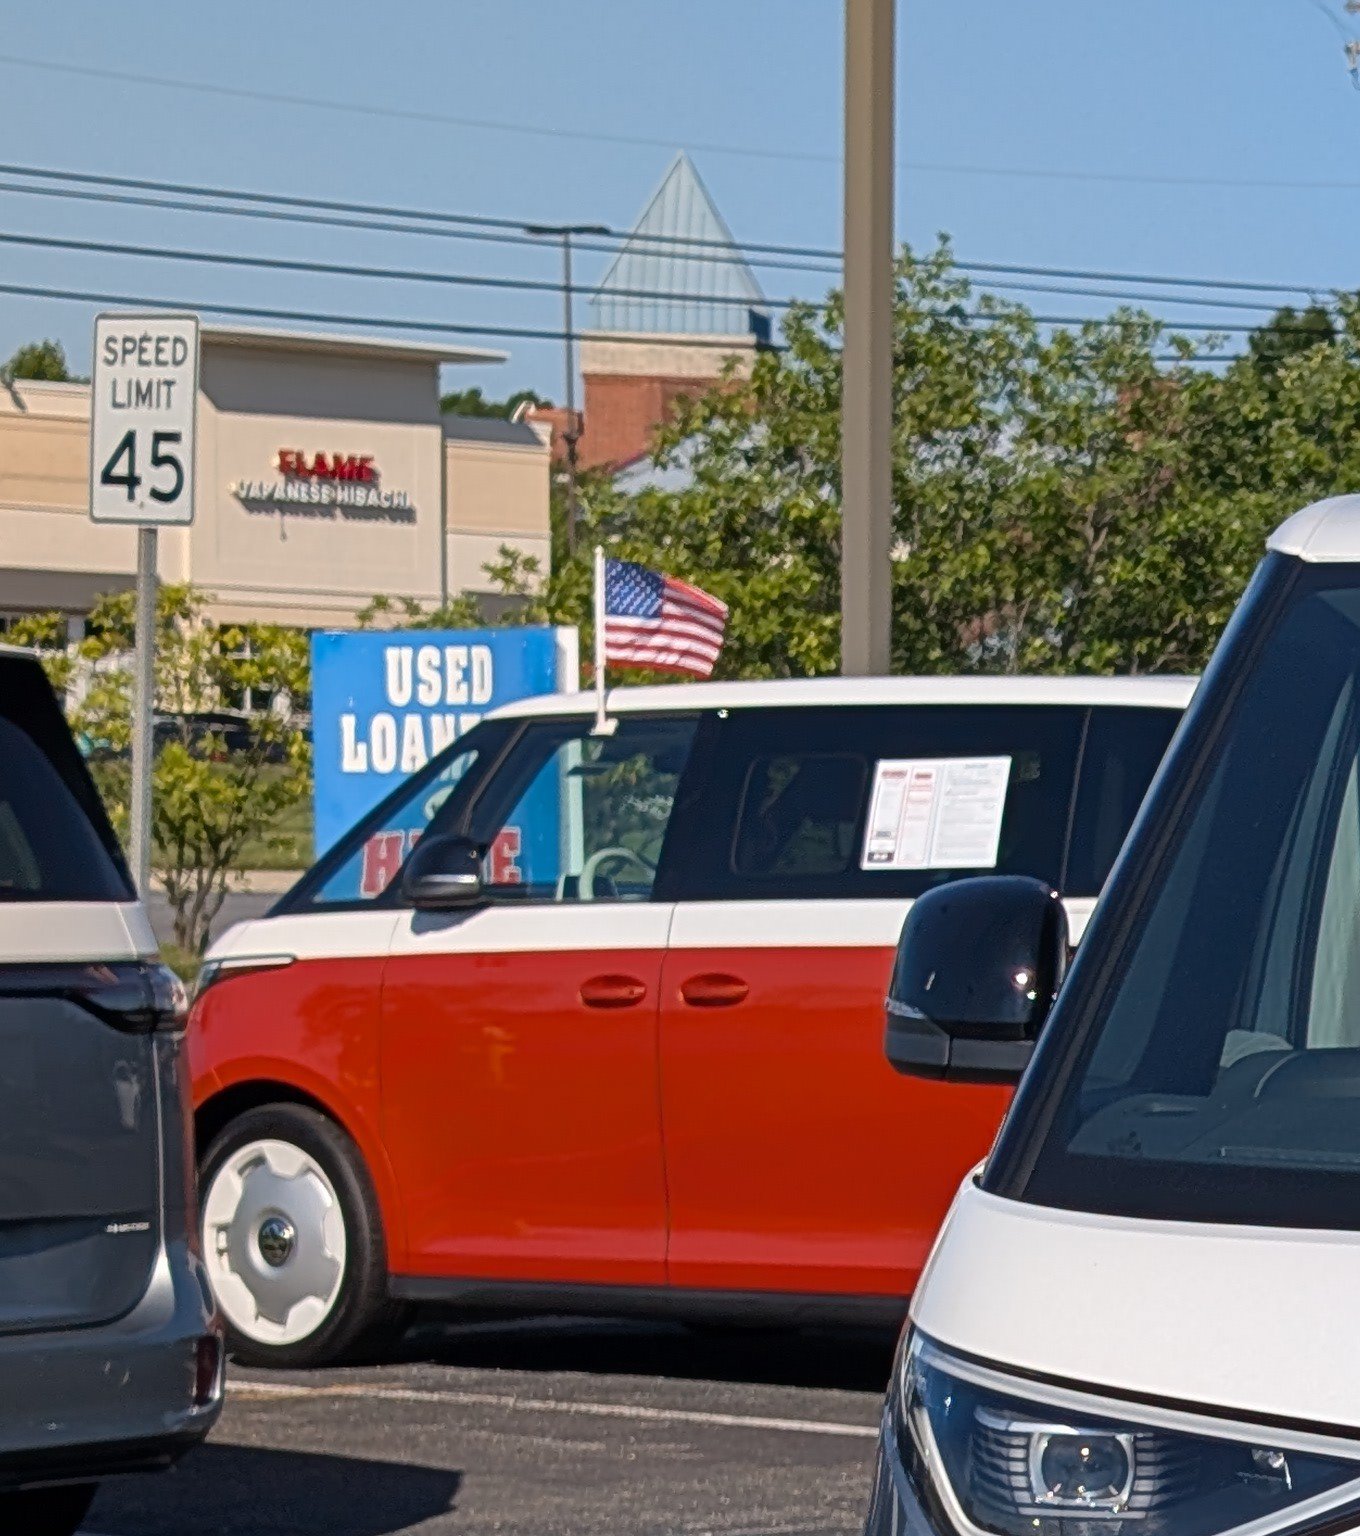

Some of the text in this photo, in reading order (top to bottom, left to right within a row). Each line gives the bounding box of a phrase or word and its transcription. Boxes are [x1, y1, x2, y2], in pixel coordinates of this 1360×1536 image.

[103, 334, 188, 367] SPEED
[111, 376, 176, 411] LIMIT
[101, 428, 185, 503] 45
[385, 645, 494, 706] USED
